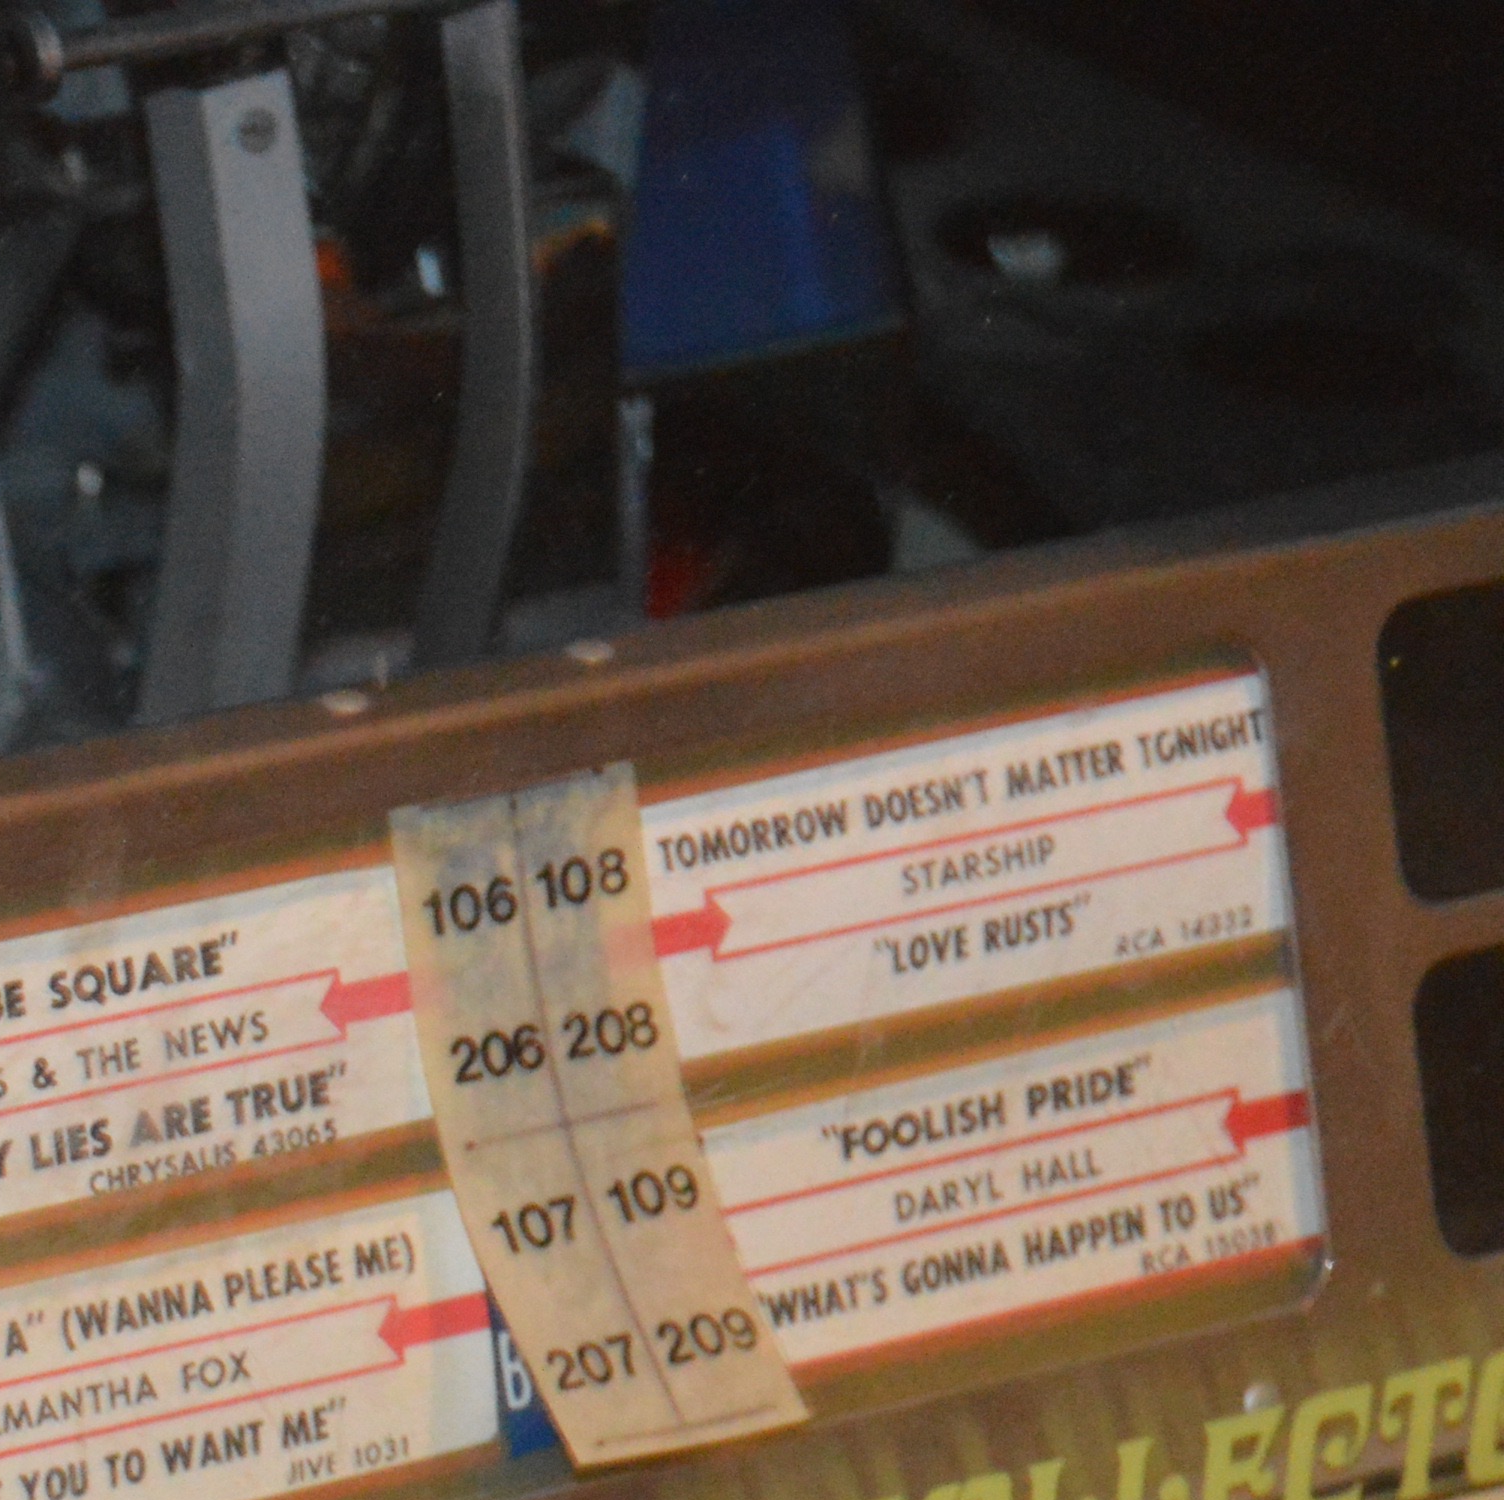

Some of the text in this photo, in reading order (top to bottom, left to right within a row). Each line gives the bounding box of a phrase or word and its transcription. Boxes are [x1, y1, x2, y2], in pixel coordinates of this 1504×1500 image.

[658, 801, 850, 873] TOMORROW
[864, 769, 990, 829] DOESN'T
[1006, 740, 1125, 796] MATTER
[424, 848, 629, 936] 106 108
[902, 834, 1056, 894] STARSHIP
[49, 931, 238, 1011] SQUARE"
[31, 1057, 58, 1091] &
[76, 1038, 142, 1081] THE
[165, 1011, 270, 1063] NEWS
[451, 1003, 659, 1084] 206 208
[30, 1119, 113, 1170] LIES
[130, 1096, 214, 1149] ARE
[226, 1062, 347, 1125] TRUE"
[821, 1056, 1152, 1161] "FOOLISH PRIDE"
[90, 1142, 240, 1196] CHRYSALIS
[493, 1163, 700, 1254] 107 109
[894, 1149, 1102, 1224] DARYL HALL
[901, 1240, 1009, 1296] GONNA
[1023, 1212, 1146, 1266] HAPPEN
[1161, 1193, 1197, 1231] TO
[61, 1283, 215, 1353] (WANNA
[225, 1255, 344, 1316] PLEASE
[354, 1231, 416, 1283] ME)
[182, 1350, 251, 1394] FOX
[547, 1307, 757, 1392] 207 209
[104, 1449, 146, 1488] TO
[160, 1418, 264, 1476] WANT
[280, 1397, 347, 1450] ME"
[353, 1435, 411, 1474] 1031
